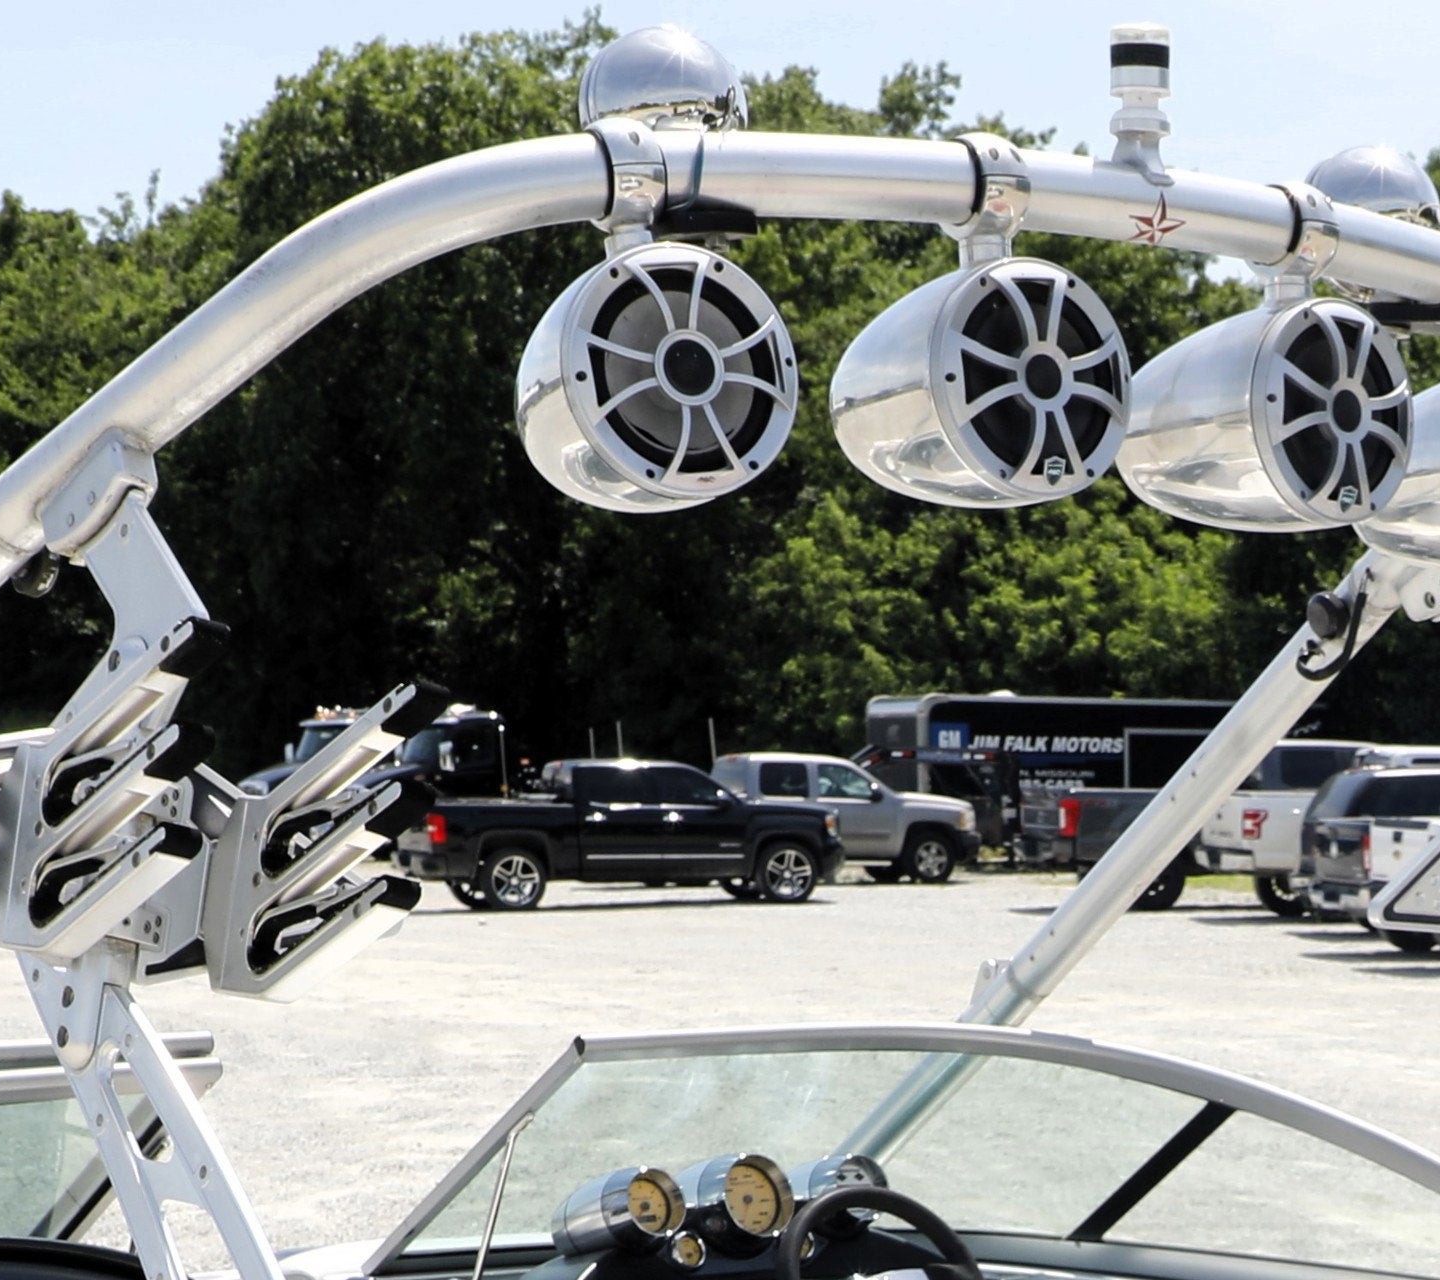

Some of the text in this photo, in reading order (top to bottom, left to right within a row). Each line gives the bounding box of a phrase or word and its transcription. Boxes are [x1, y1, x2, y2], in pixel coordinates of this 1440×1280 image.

[937, 729, 961, 749] GM
[967, 734, 1124, 754] JIM FALK MOTORS
